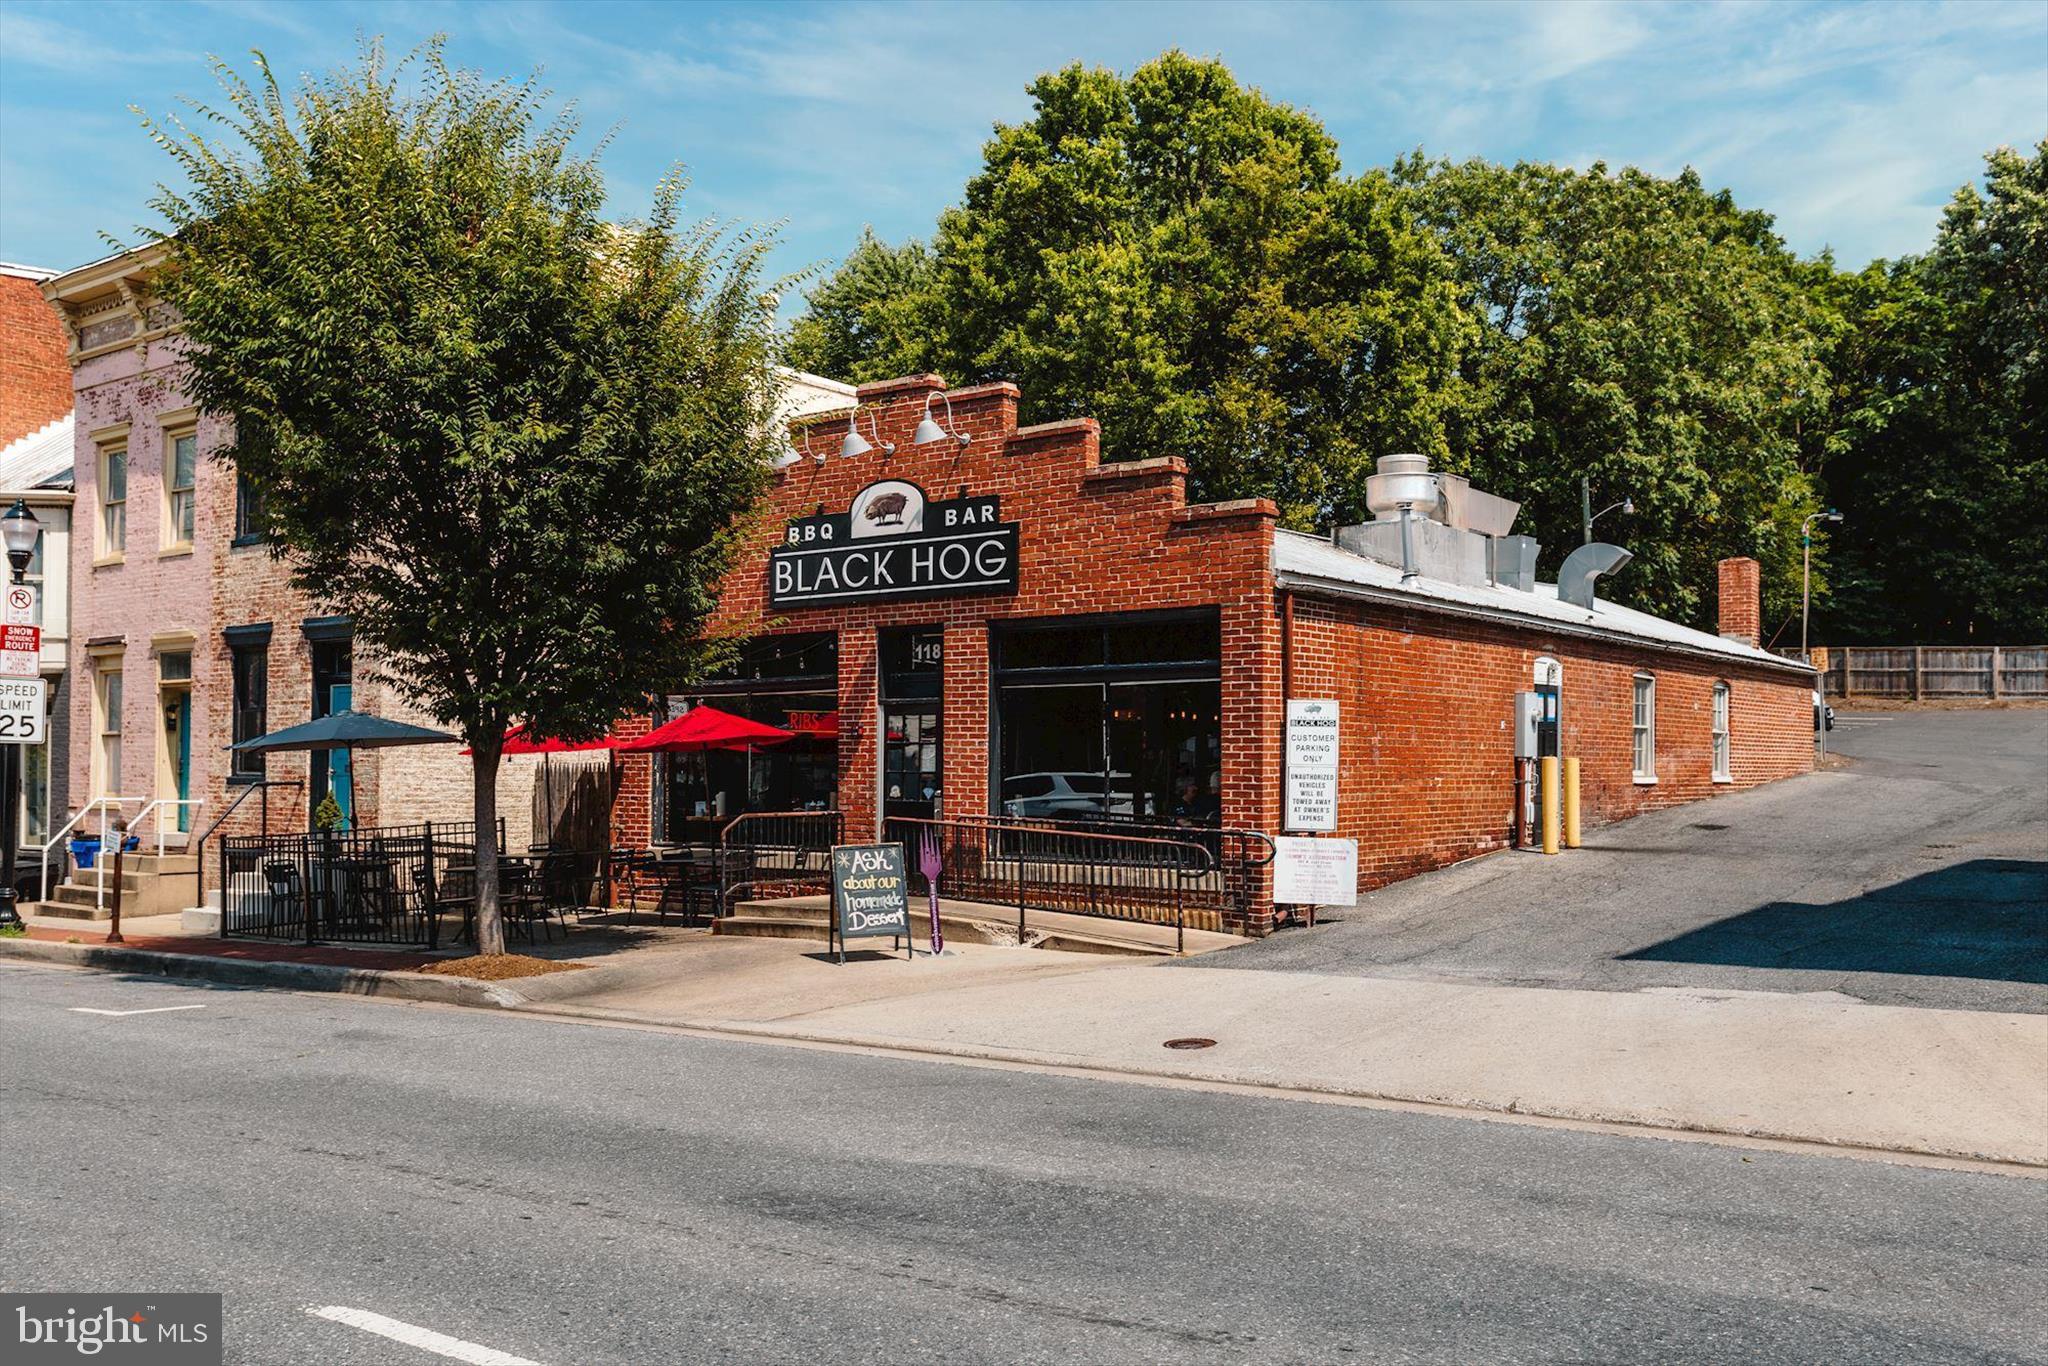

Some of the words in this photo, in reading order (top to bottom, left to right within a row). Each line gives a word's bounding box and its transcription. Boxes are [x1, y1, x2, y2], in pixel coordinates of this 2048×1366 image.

[788, 523, 834, 543] BBQ
[944, 505, 995, 527] BAR
[775, 549, 894, 595] BLACK
[911, 540, 1007, 583] HOG
[7, 627, 34, 636] SNOW
[4, 641, 35, 651] ROUTE
[915, 644, 942, 660] 118
[0, 685, 38, 697] SPEED
[0, 700, 32, 711] LIMIT
[0, 714, 35, 738] 25
[790, 712, 820, 730] RIBS
[1296, 745, 1330, 753] PARKING
[1303, 755, 1323, 763] ONLY
[1291, 773, 1334, 781] UNAUTHORIZED
[842, 874, 877, 890] about
[877, 876, 901, 890] our
[844, 890, 904, 912] homemade
